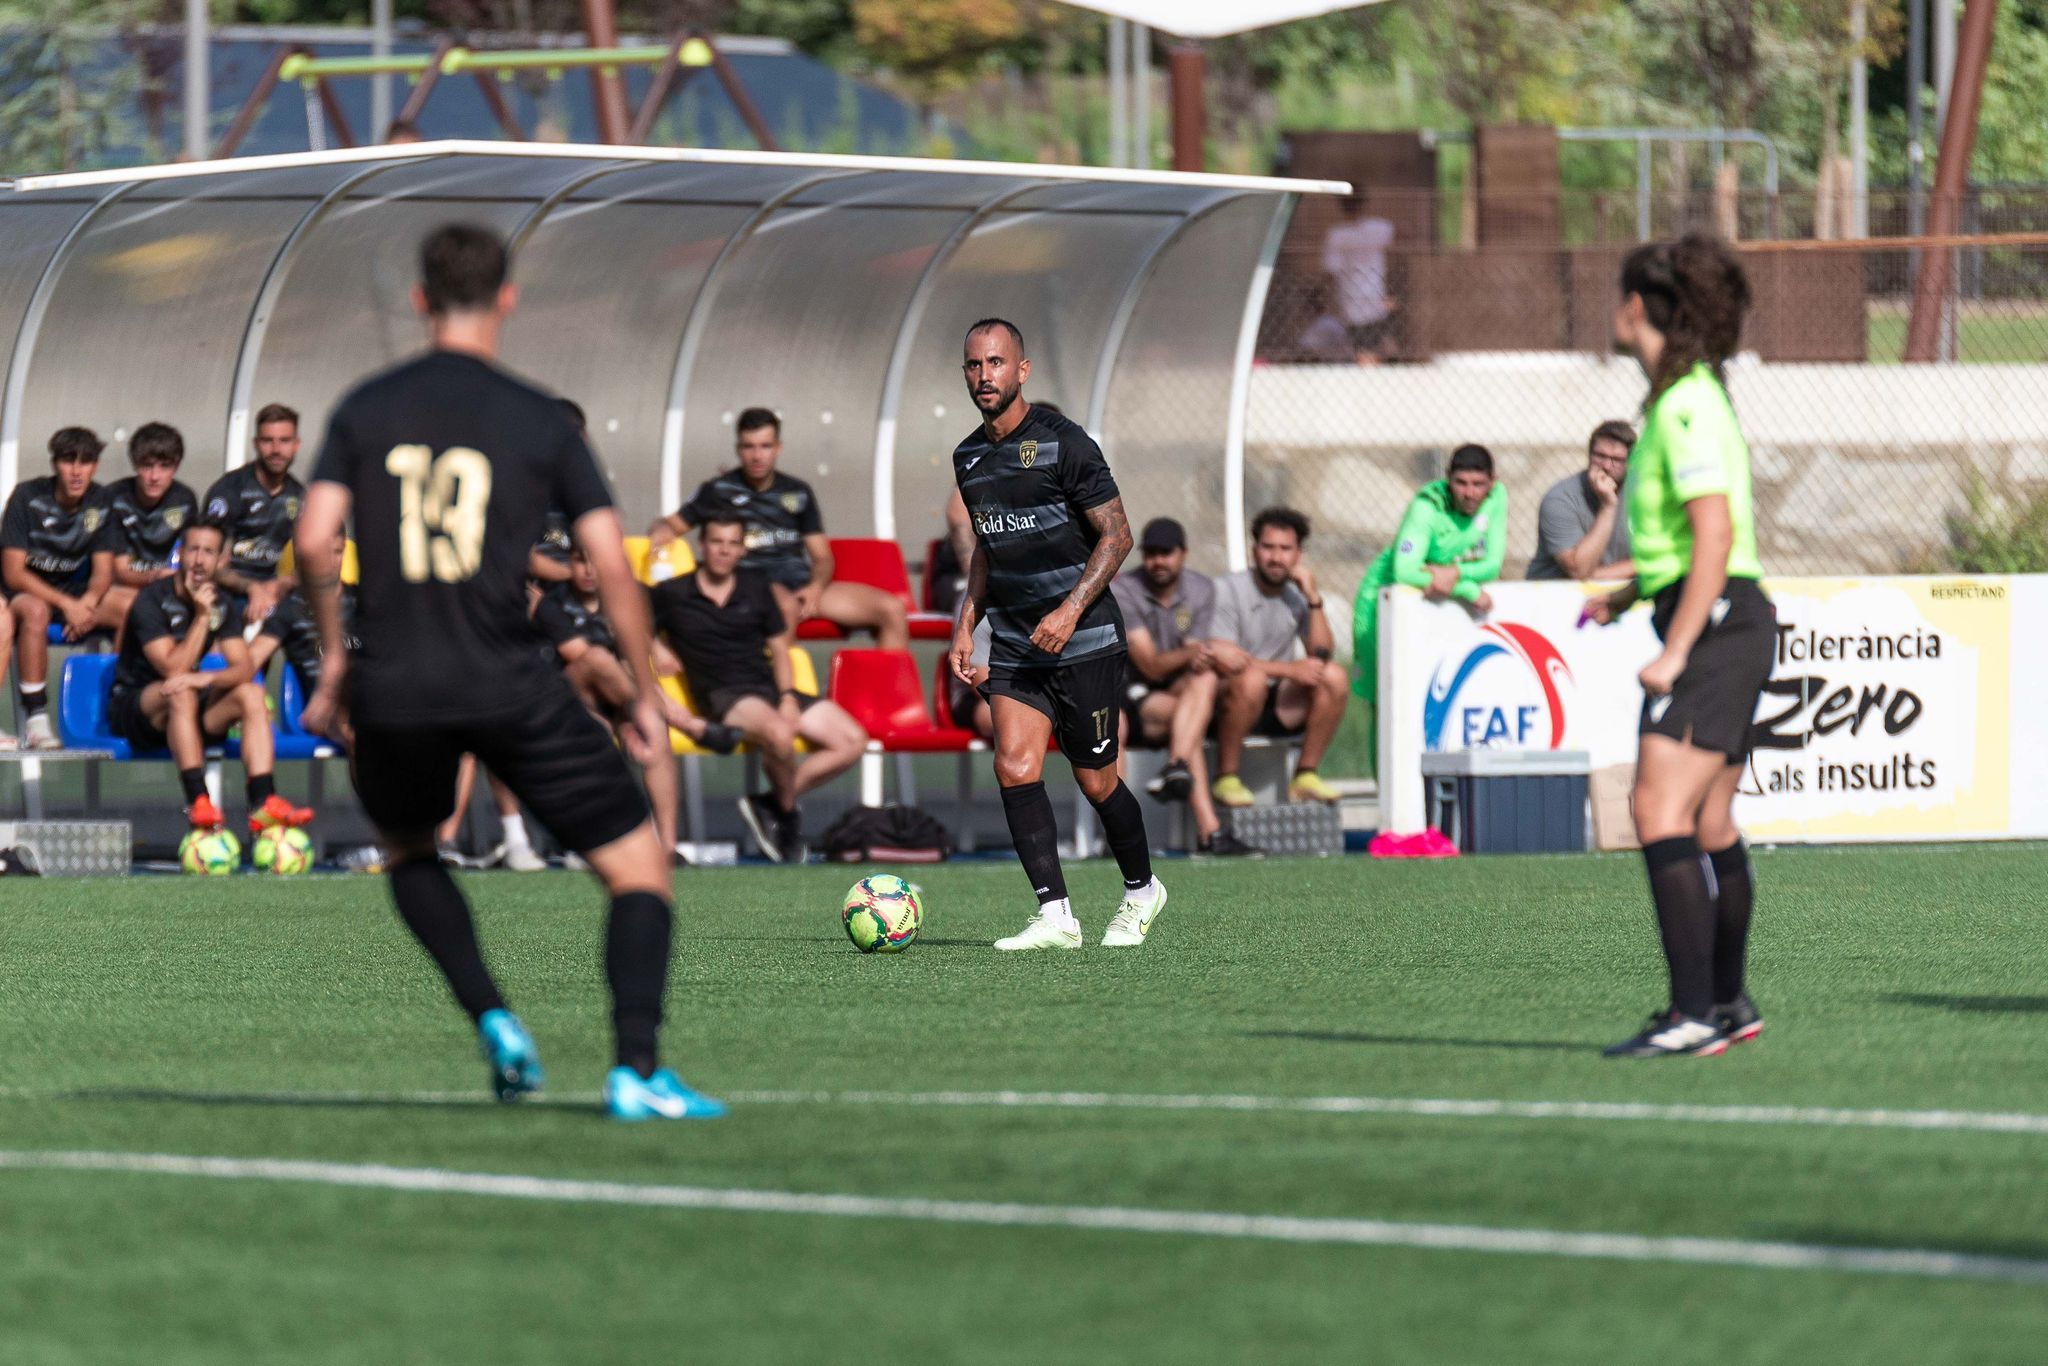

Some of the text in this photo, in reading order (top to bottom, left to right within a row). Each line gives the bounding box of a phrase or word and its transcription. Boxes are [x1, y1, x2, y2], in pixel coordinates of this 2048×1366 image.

[385, 444, 491, 583] 19
[1007, 513, 1036, 531] Star
[1776, 624, 1941, 665] Tolerància
[1092, 707, 1109, 740] 17
[1751, 676, 1922, 749] Zero
[1769, 753, 1938, 793] als insults
